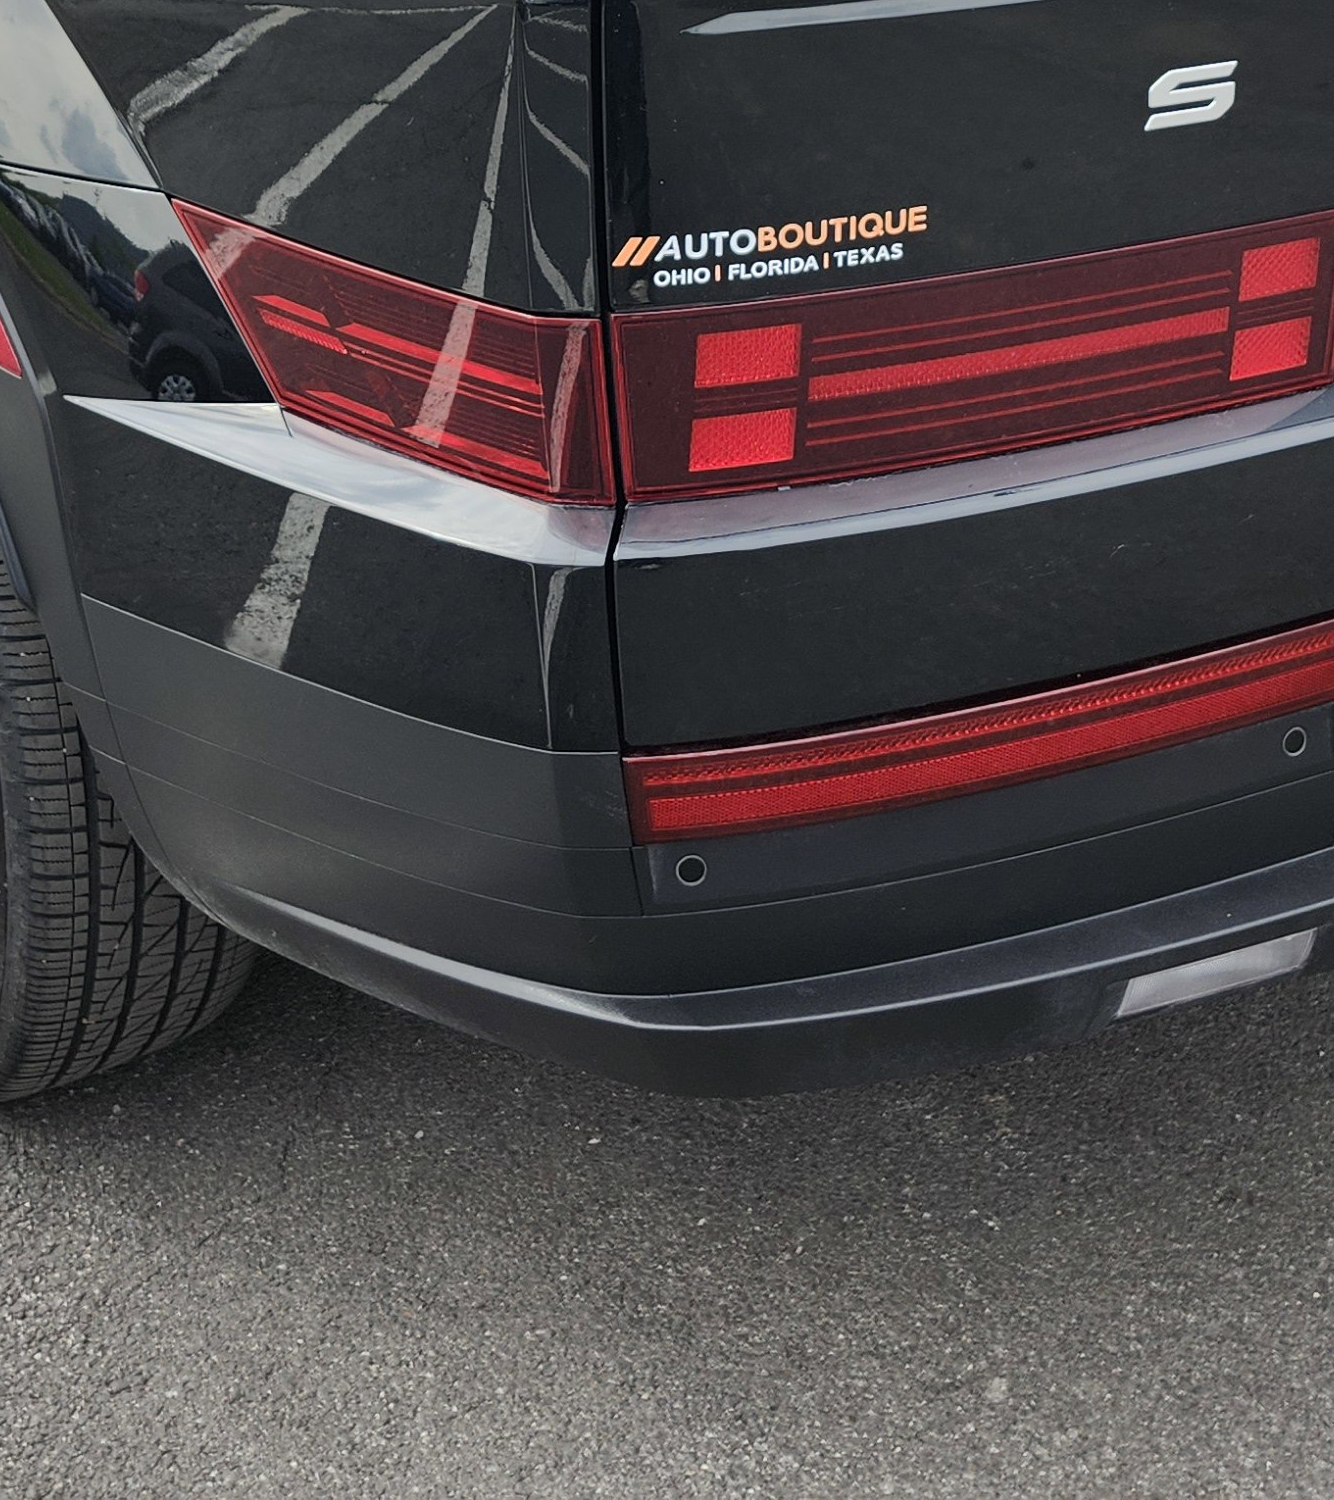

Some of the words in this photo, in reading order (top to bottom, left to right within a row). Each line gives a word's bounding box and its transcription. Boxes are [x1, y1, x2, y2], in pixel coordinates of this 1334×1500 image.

[653, 205, 928, 262] AUTOBOUTIQUE
[652, 266, 711, 288] OHIO
[727, 254, 819, 282] FLORIDA
[833, 243, 904, 268] TEXAS
